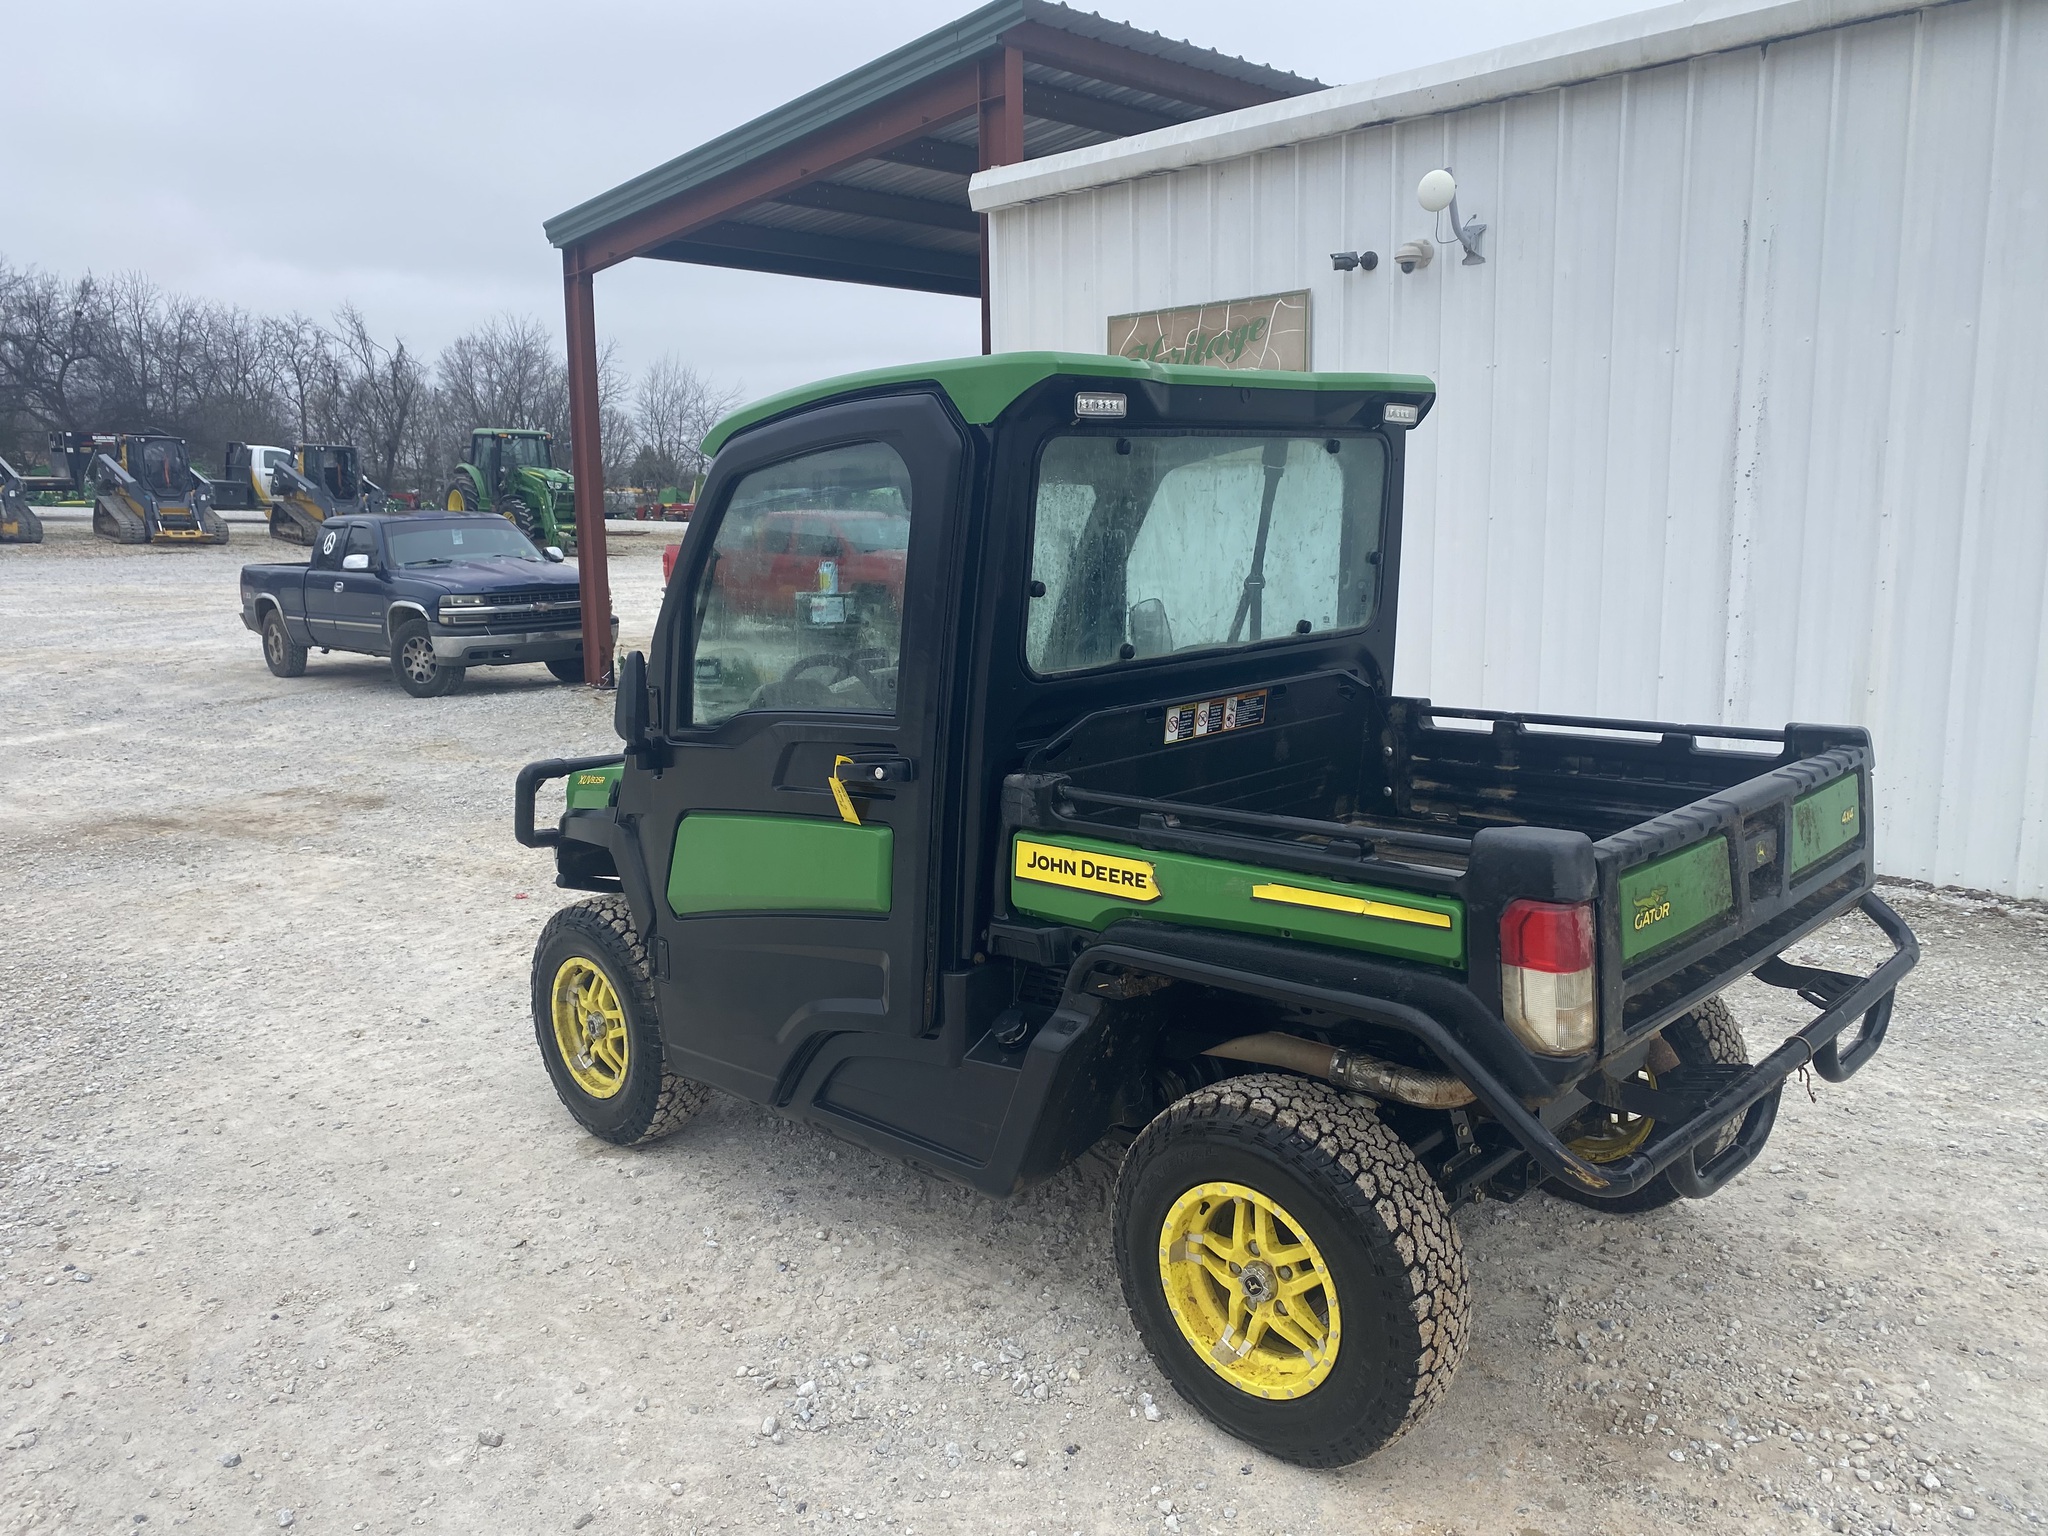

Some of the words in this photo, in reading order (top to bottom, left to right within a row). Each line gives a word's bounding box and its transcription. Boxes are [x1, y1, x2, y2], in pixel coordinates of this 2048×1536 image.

[1027, 851, 1077, 875] JOHN
[1081, 859, 1147, 889] DEERE
[1634, 902, 1671, 931] GATOR
